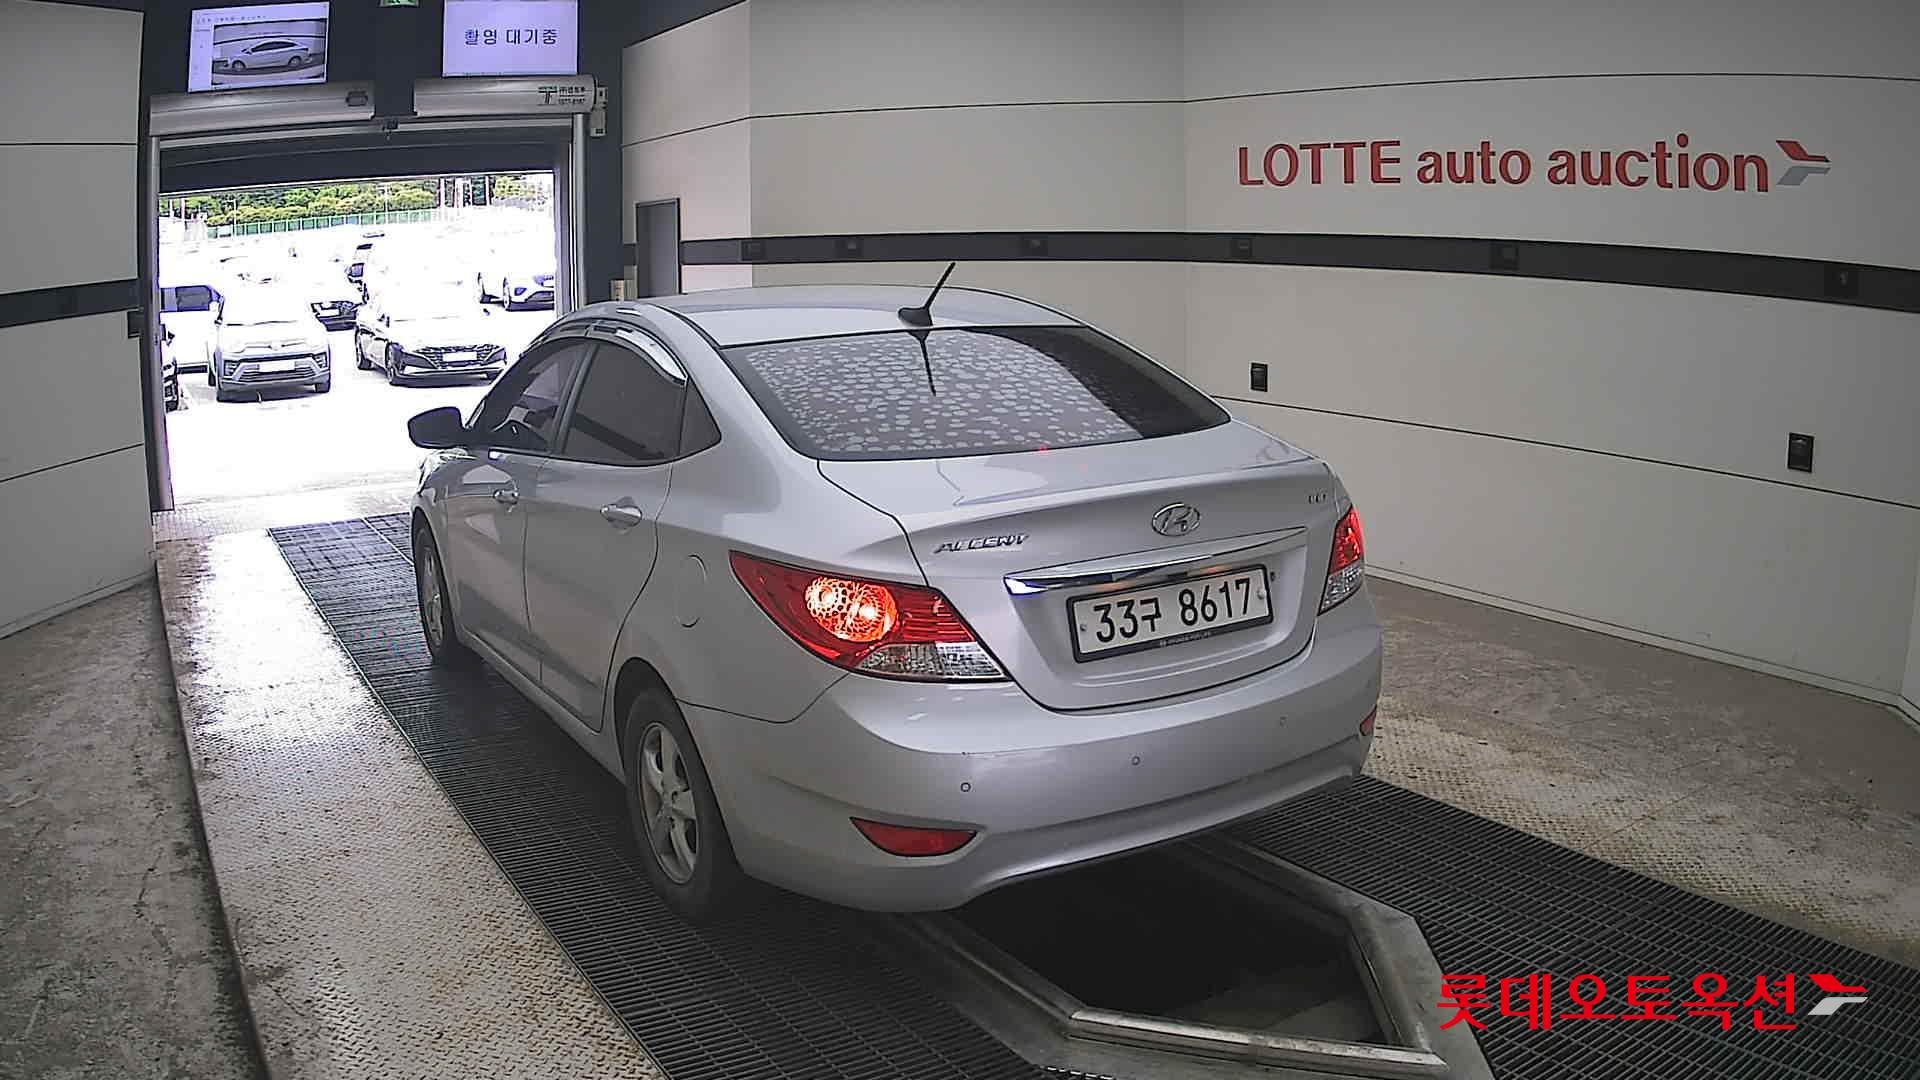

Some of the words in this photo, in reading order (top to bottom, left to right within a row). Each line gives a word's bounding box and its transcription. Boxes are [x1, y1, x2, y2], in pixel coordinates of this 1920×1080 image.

[465, 28, 497, 45] 촬영
[506, 28, 558, 45] 대기중
[1238, 139, 1400, 187] LOTTE
[1416, 140, 1531, 185] auto
[1547, 133, 1768, 192] auction
[1094, 597, 1162, 642] 33구
[1178, 577, 1251, 626] 8617
